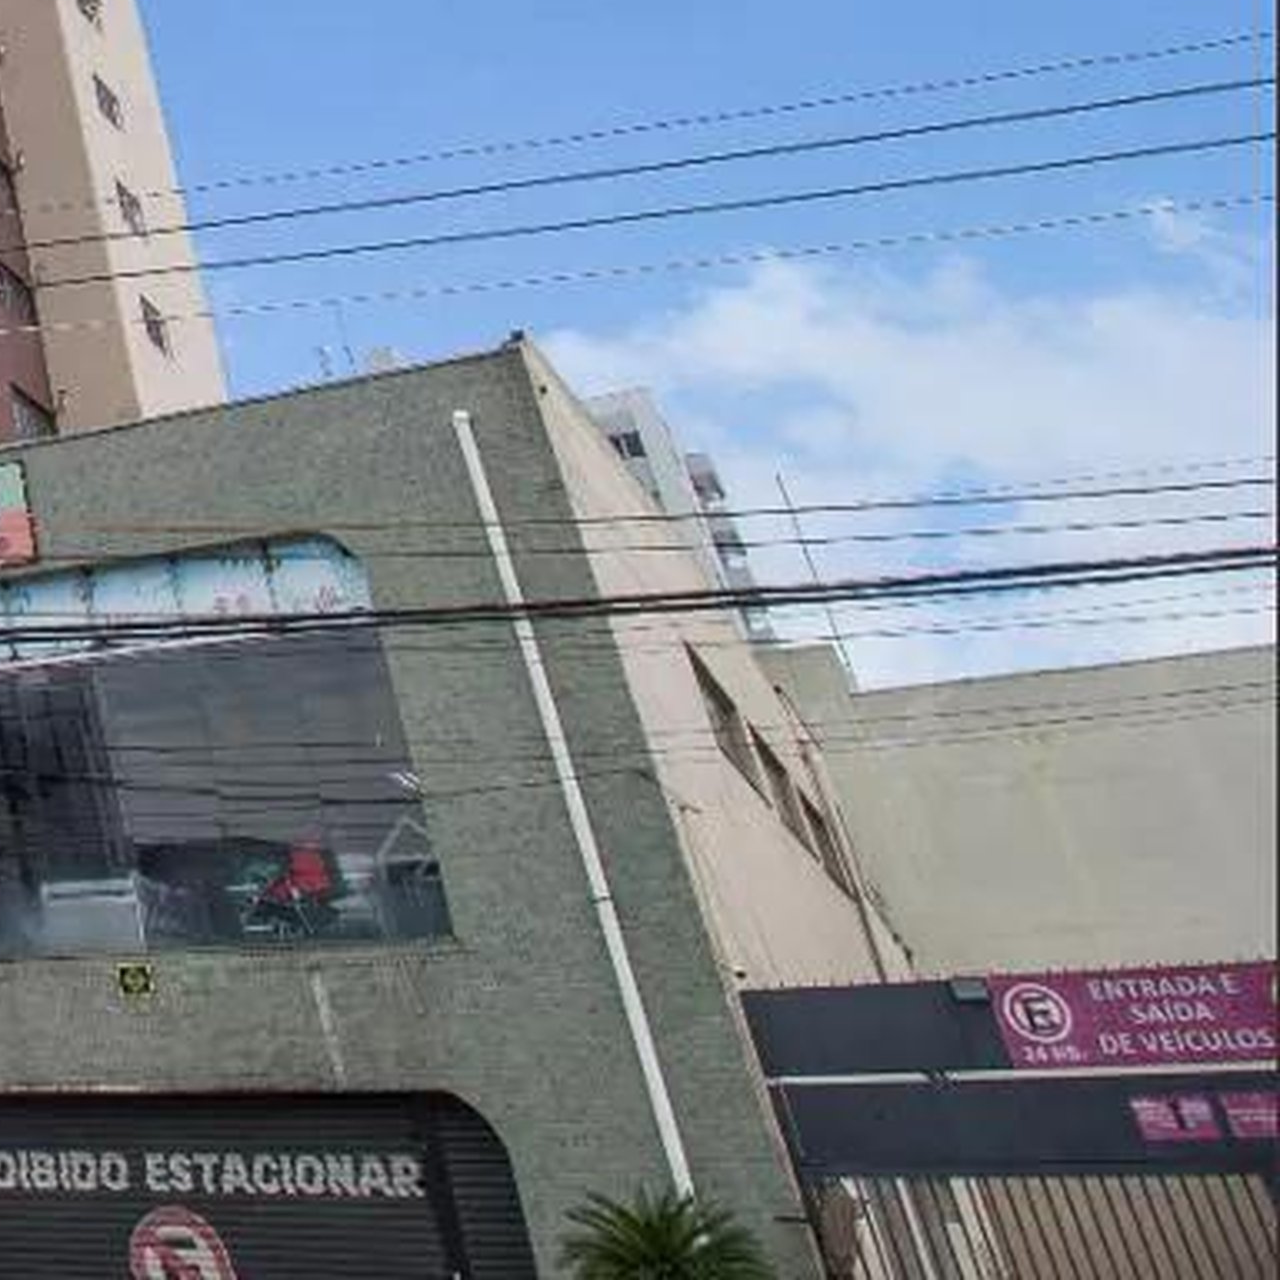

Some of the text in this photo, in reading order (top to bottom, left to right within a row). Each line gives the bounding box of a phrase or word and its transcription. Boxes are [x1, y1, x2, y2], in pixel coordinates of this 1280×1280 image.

[1086, 971, 1242, 1002] ENTRADA E
[1128, 997, 1215, 1025] SAÍDA
[1097, 1027, 1276, 1056] DE VEÍCULOS
[143, 1150, 426, 1198] ESTACIONAR
